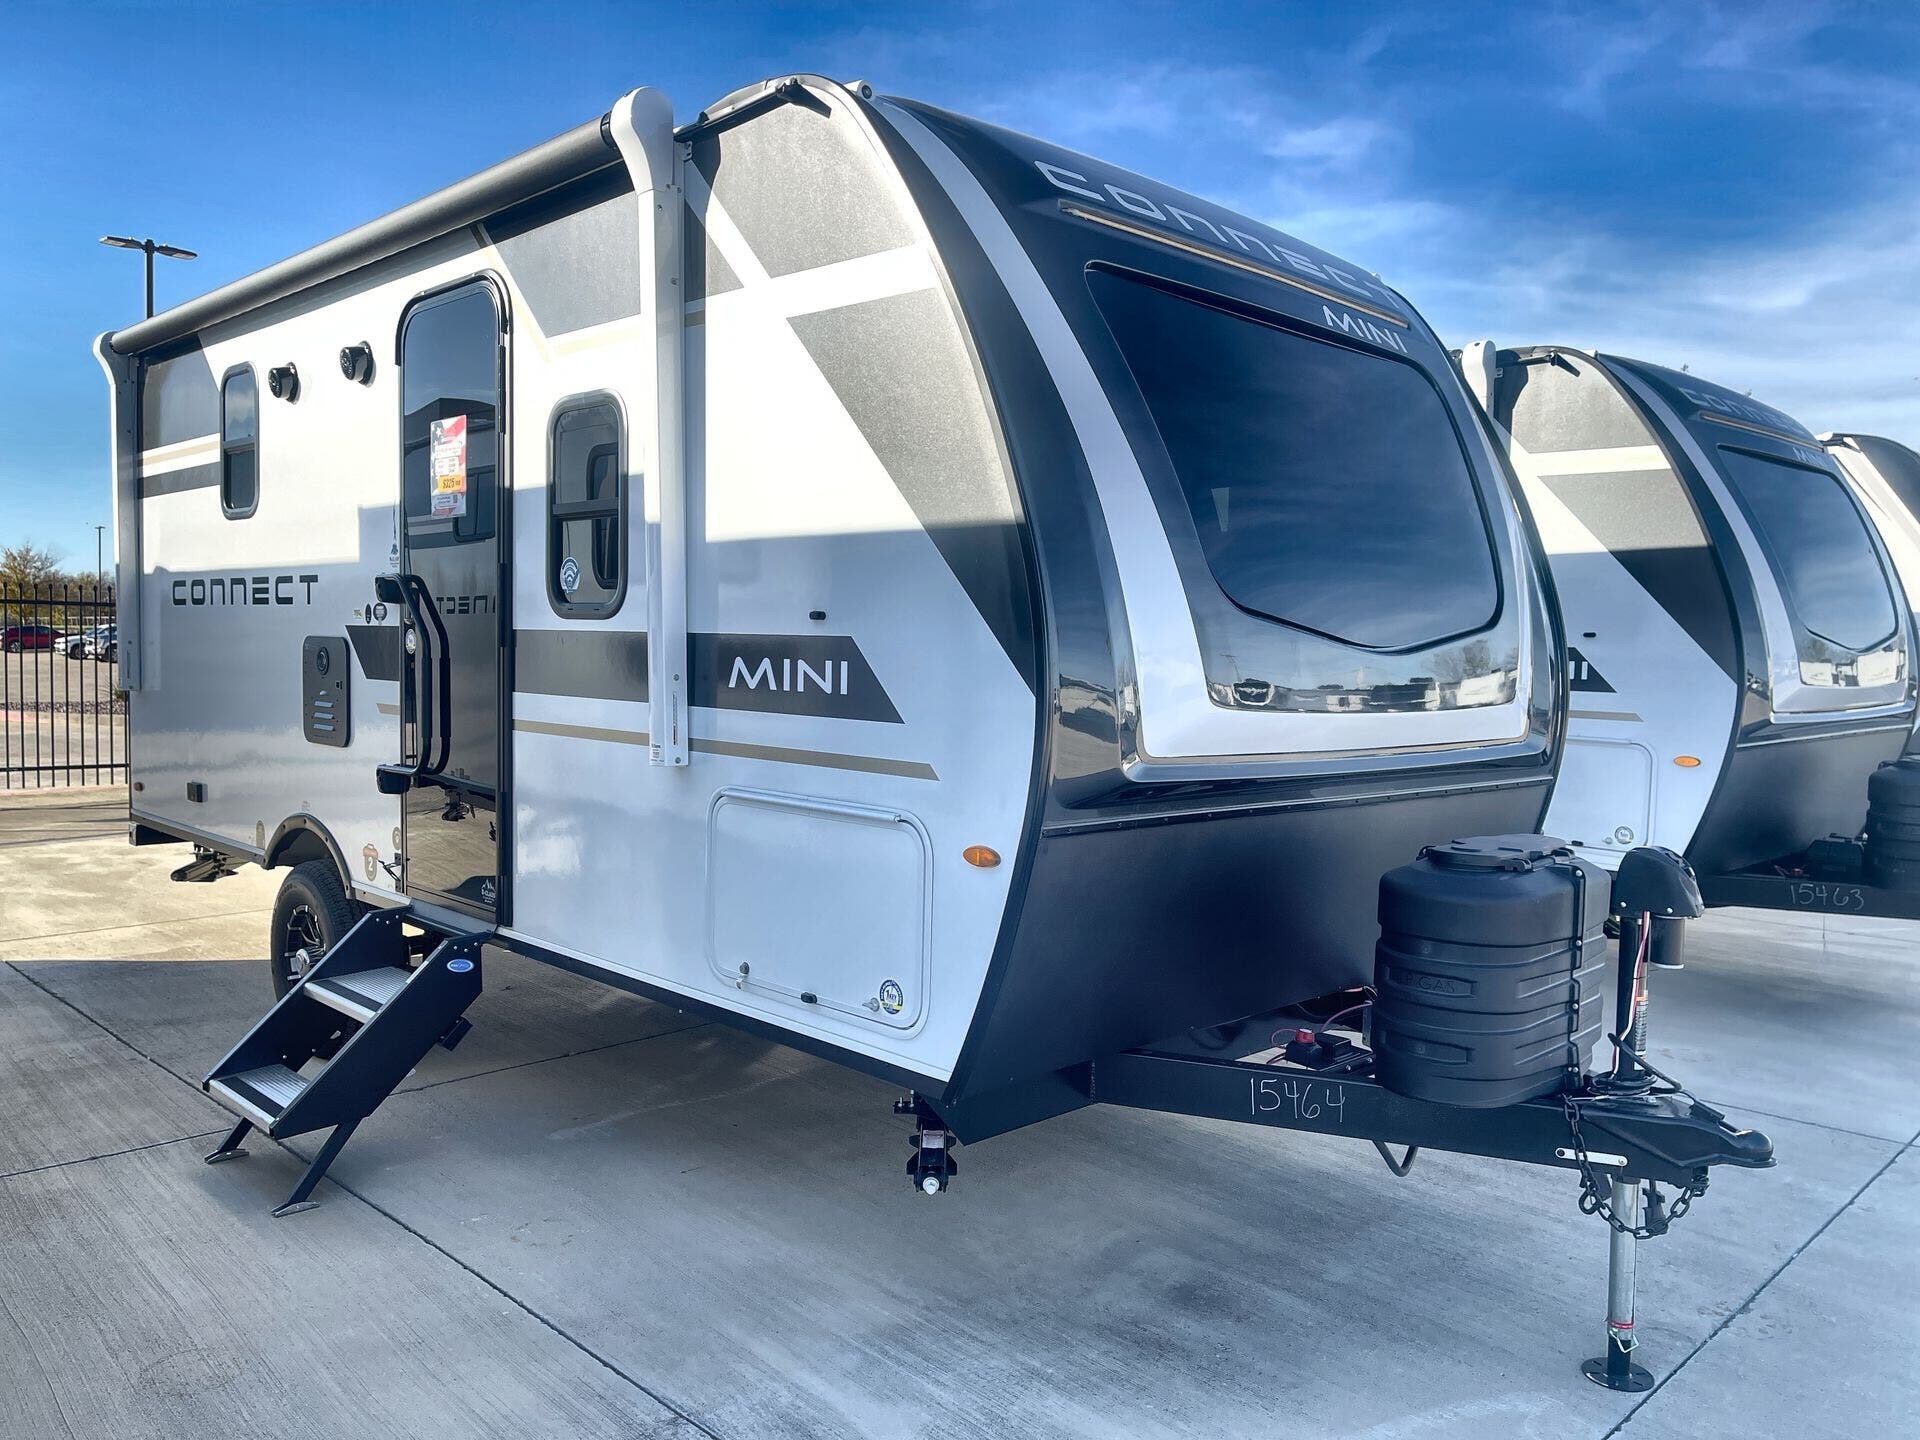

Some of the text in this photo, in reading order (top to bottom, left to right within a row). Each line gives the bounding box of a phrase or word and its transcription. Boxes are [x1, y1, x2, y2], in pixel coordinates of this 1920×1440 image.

[1034, 160, 1399, 309] CONNECT
[1322, 305, 1409, 353] MINI
[172, 574, 318, 606] CONNECT
[728, 656, 848, 695] MINI
[1790, 883, 1864, 911] 15463
[1420, 976, 1456, 993] GAS
[1250, 1078, 1346, 1123] 15464
